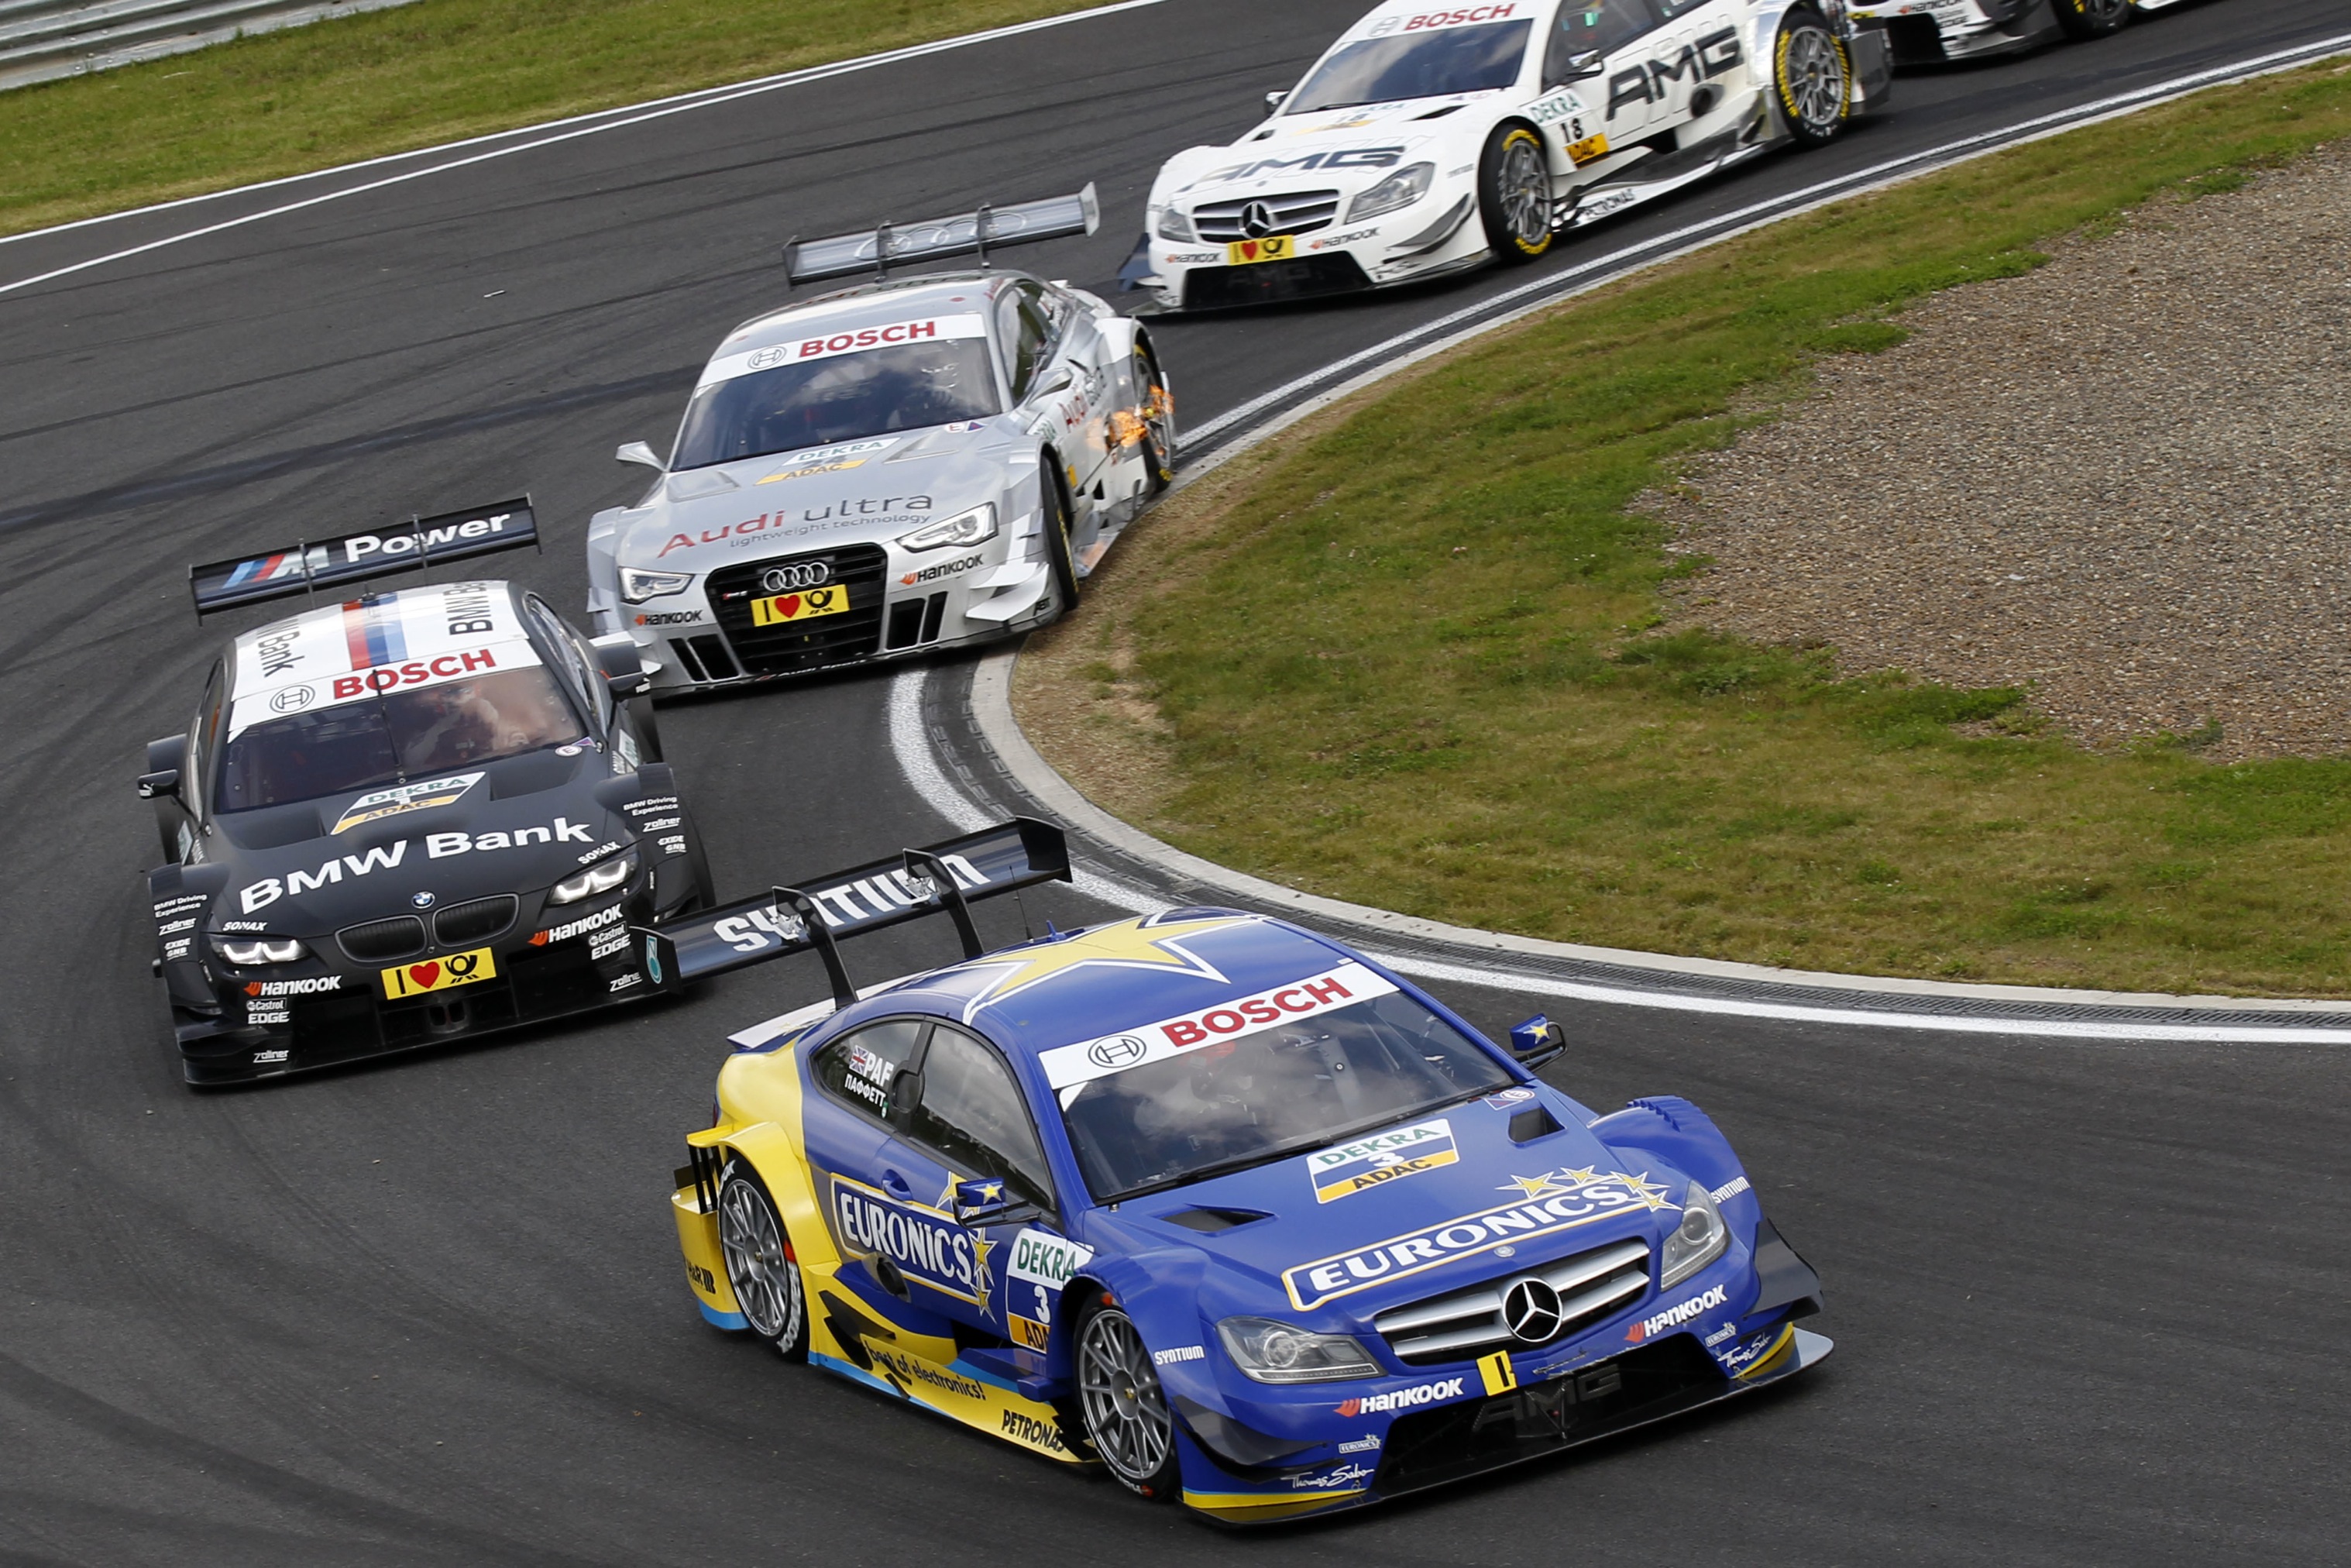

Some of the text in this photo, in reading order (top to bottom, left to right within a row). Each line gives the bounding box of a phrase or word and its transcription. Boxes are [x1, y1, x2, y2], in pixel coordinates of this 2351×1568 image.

[1403, 3, 1517, 31] BOSCH
[1605, 24, 1745, 122] AMG
[1529, 93, 1582, 124] DEKRA
[1560, 118, 1583, 143] 18
[1175, 145, 1406, 194] AMG
[799, 321, 936, 358] BOSCH
[798, 441, 885, 462] DEKRA
[782, 463, 843, 480] ADAC
[344, 513, 510, 563] Power
[657, 494, 933, 559] Audi ultra
[730, 512, 932, 548] lightweight technology
[444, 595, 493, 635] BMW
[258, 631, 306, 679] Bank
[332, 648, 497, 700] BOSCH
[367, 777, 469, 803] DEKRA
[623, 796, 678, 812] BMW Driving
[363, 800, 432, 821] ADAC
[631, 803, 679, 817] Experience
[239, 839, 408, 916] BMW
[424, 817, 595, 859] Bank
[577, 841, 621, 865] SONAX
[153, 893, 208, 911] BMW Driving
[155, 901, 201, 918] Experience
[222, 920, 268, 932] SONAX
[597, 924, 625, 944] Castrol
[591, 934, 631, 961] EDGE
[247, 1011, 290, 1025] EDGE
[254, 999, 284, 1011] Castrol
[1159, 976, 1355, 1048] BOSCH
[844, 1073, 887, 1108] ПАФФЕТТ
[1316, 1128, 1441, 1166] DEKRA
[1367, 1151, 1405, 1167] 3
[1352, 1159, 1433, 1190] ADAC
[1710, 1175, 1751, 1205] SYNTIUM
[840, 1191, 972, 1285] EURONICS
[1308, 1185, 1631, 1291] EURONICS
[1016, 1237, 1076, 1282] DEKRA
[1033, 1284, 1050, 1324] 3
[1153, 1345, 1205, 1366] SYNTIUM
[896, 1353, 912, 1375] of
[912, 1359, 986, 1401] electronics!
[1001, 1408, 1064, 1453] PETRONA
[1280, 1463, 1376, 1489] Thomas Sabo
